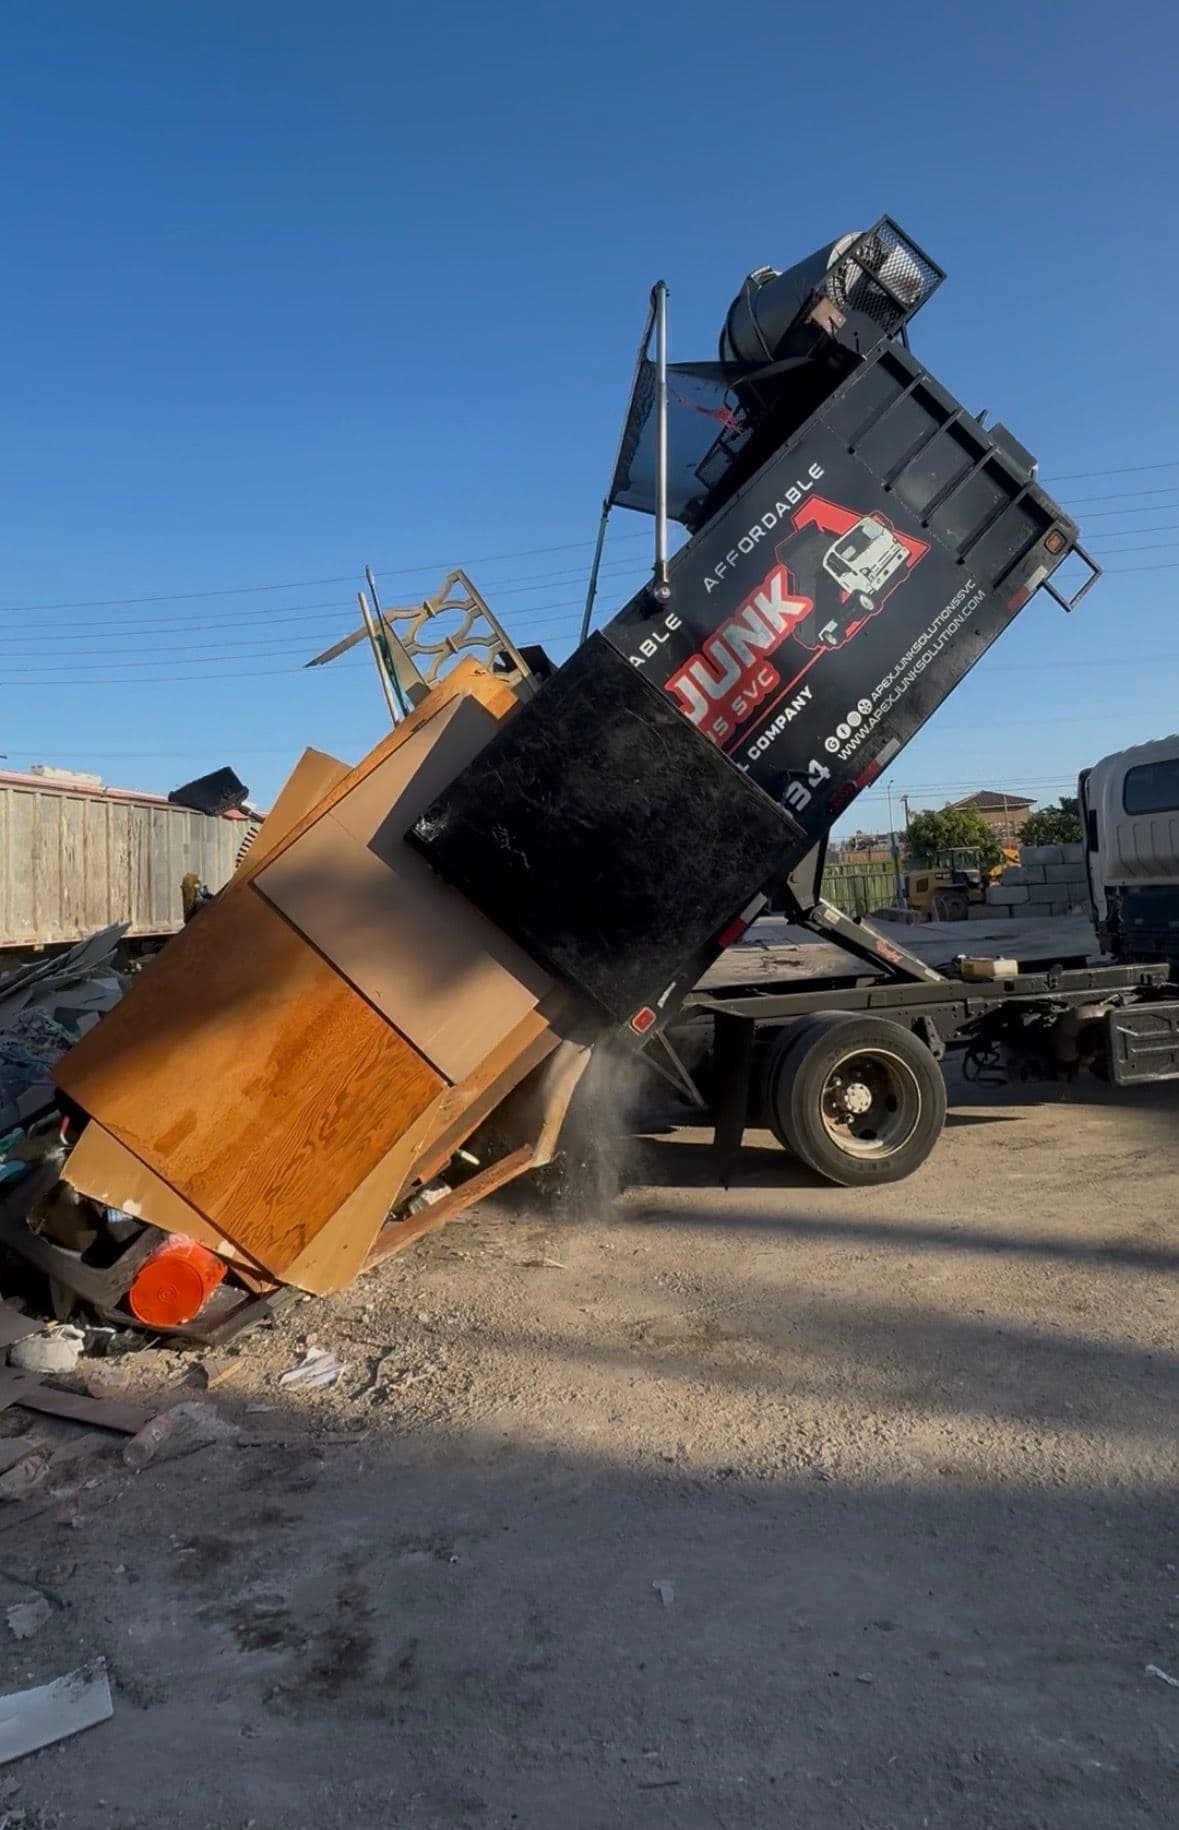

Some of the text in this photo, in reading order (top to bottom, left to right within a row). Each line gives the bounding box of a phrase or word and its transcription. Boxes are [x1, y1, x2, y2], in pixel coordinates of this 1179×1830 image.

[703, 462, 825, 593] AFFORDABLE
[673, 572, 808, 726] JUNK
[731, 668, 774, 717] SVC
[838, 590, 986, 760] WWW.APEXJUNKSOLUTION.COM
[870, 579, 976, 702] APEXJUNKSOLUTIONSSVC
[748, 685, 813, 761] COMPANY
[776, 759, 831, 820] 34
